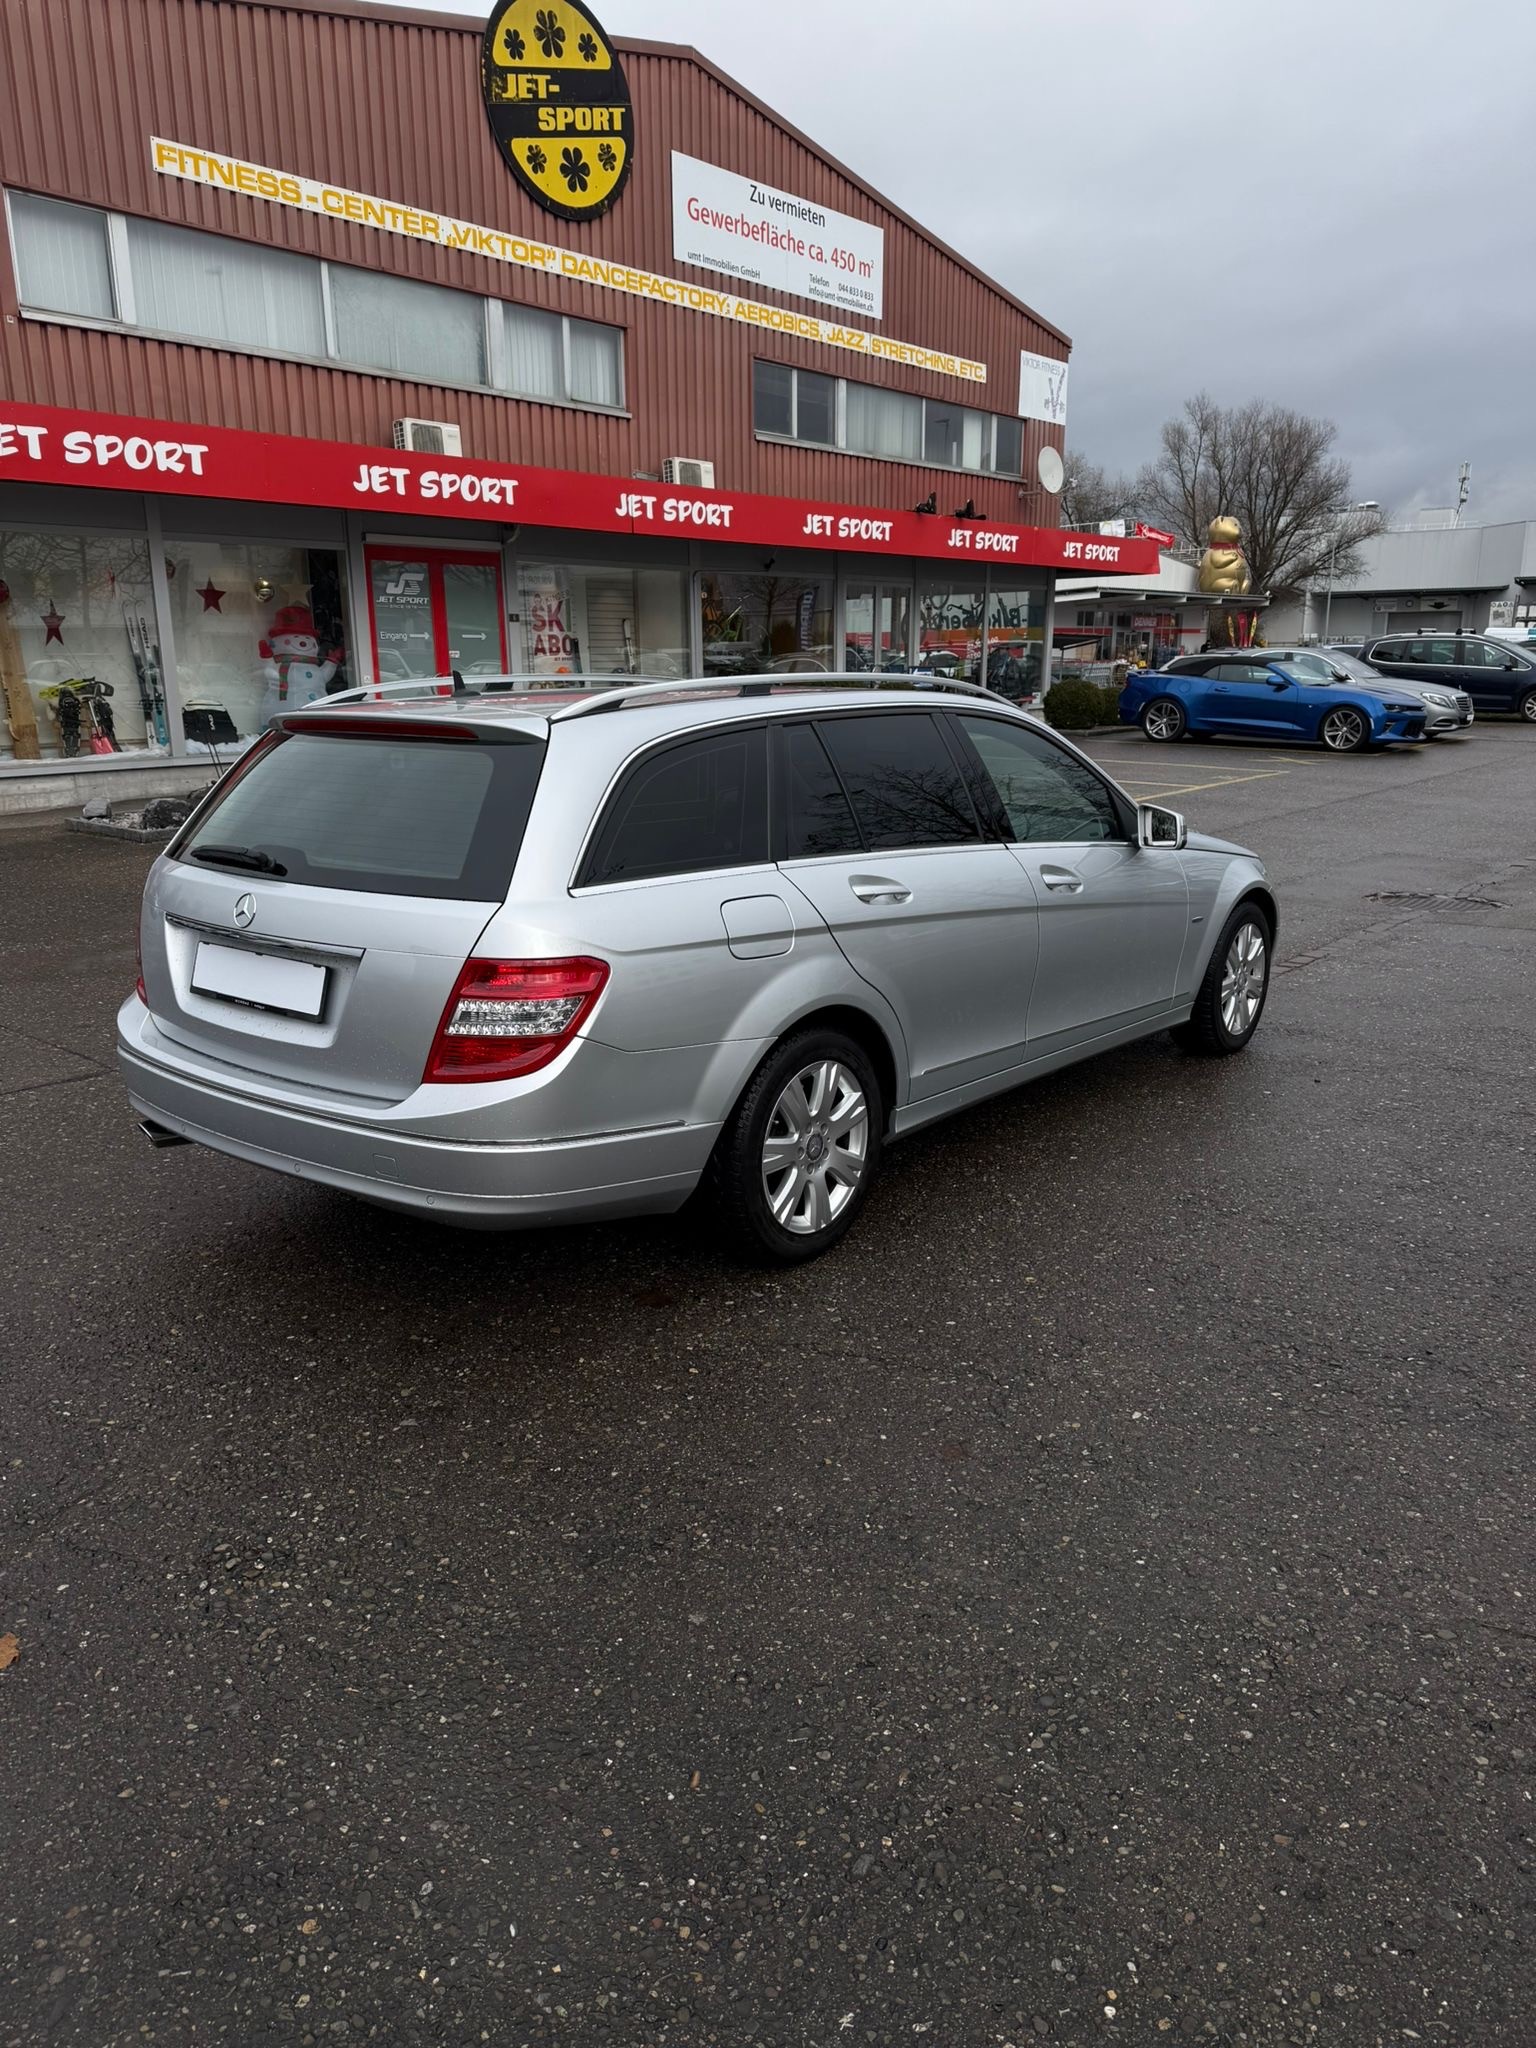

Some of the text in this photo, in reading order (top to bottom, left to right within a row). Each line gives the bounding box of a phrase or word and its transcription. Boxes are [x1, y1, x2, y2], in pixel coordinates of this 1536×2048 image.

[502, 73, 560, 99] JET-
[538, 107, 625, 131] SPORT
[749, 184, 826, 228] Zu vermieten
[687, 197, 805, 256] Gewerbefläche
[808, 244, 828, 264] ca.
[830, 247, 856, 273] 450
[687, 251, 761, 280] umt Immobilien GmbH
[809, 273, 830, 288] Telefon
[827, 326, 869, 353] JAZZ,
[960, 362, 986, 381] ETC.
[64, 430, 209, 476] SPORT
[353, 464, 519, 505] JET SPORT
[615, 493, 734, 528] JET SPORT
[803, 513, 893, 541] JET SPORT
[948, 528, 1019, 553] JET SPORT
[1063, 541, 1121, 562] JET SPORT
[376, 596, 429, 605] JET SPORT
[380, 631, 408, 642] Eingang
